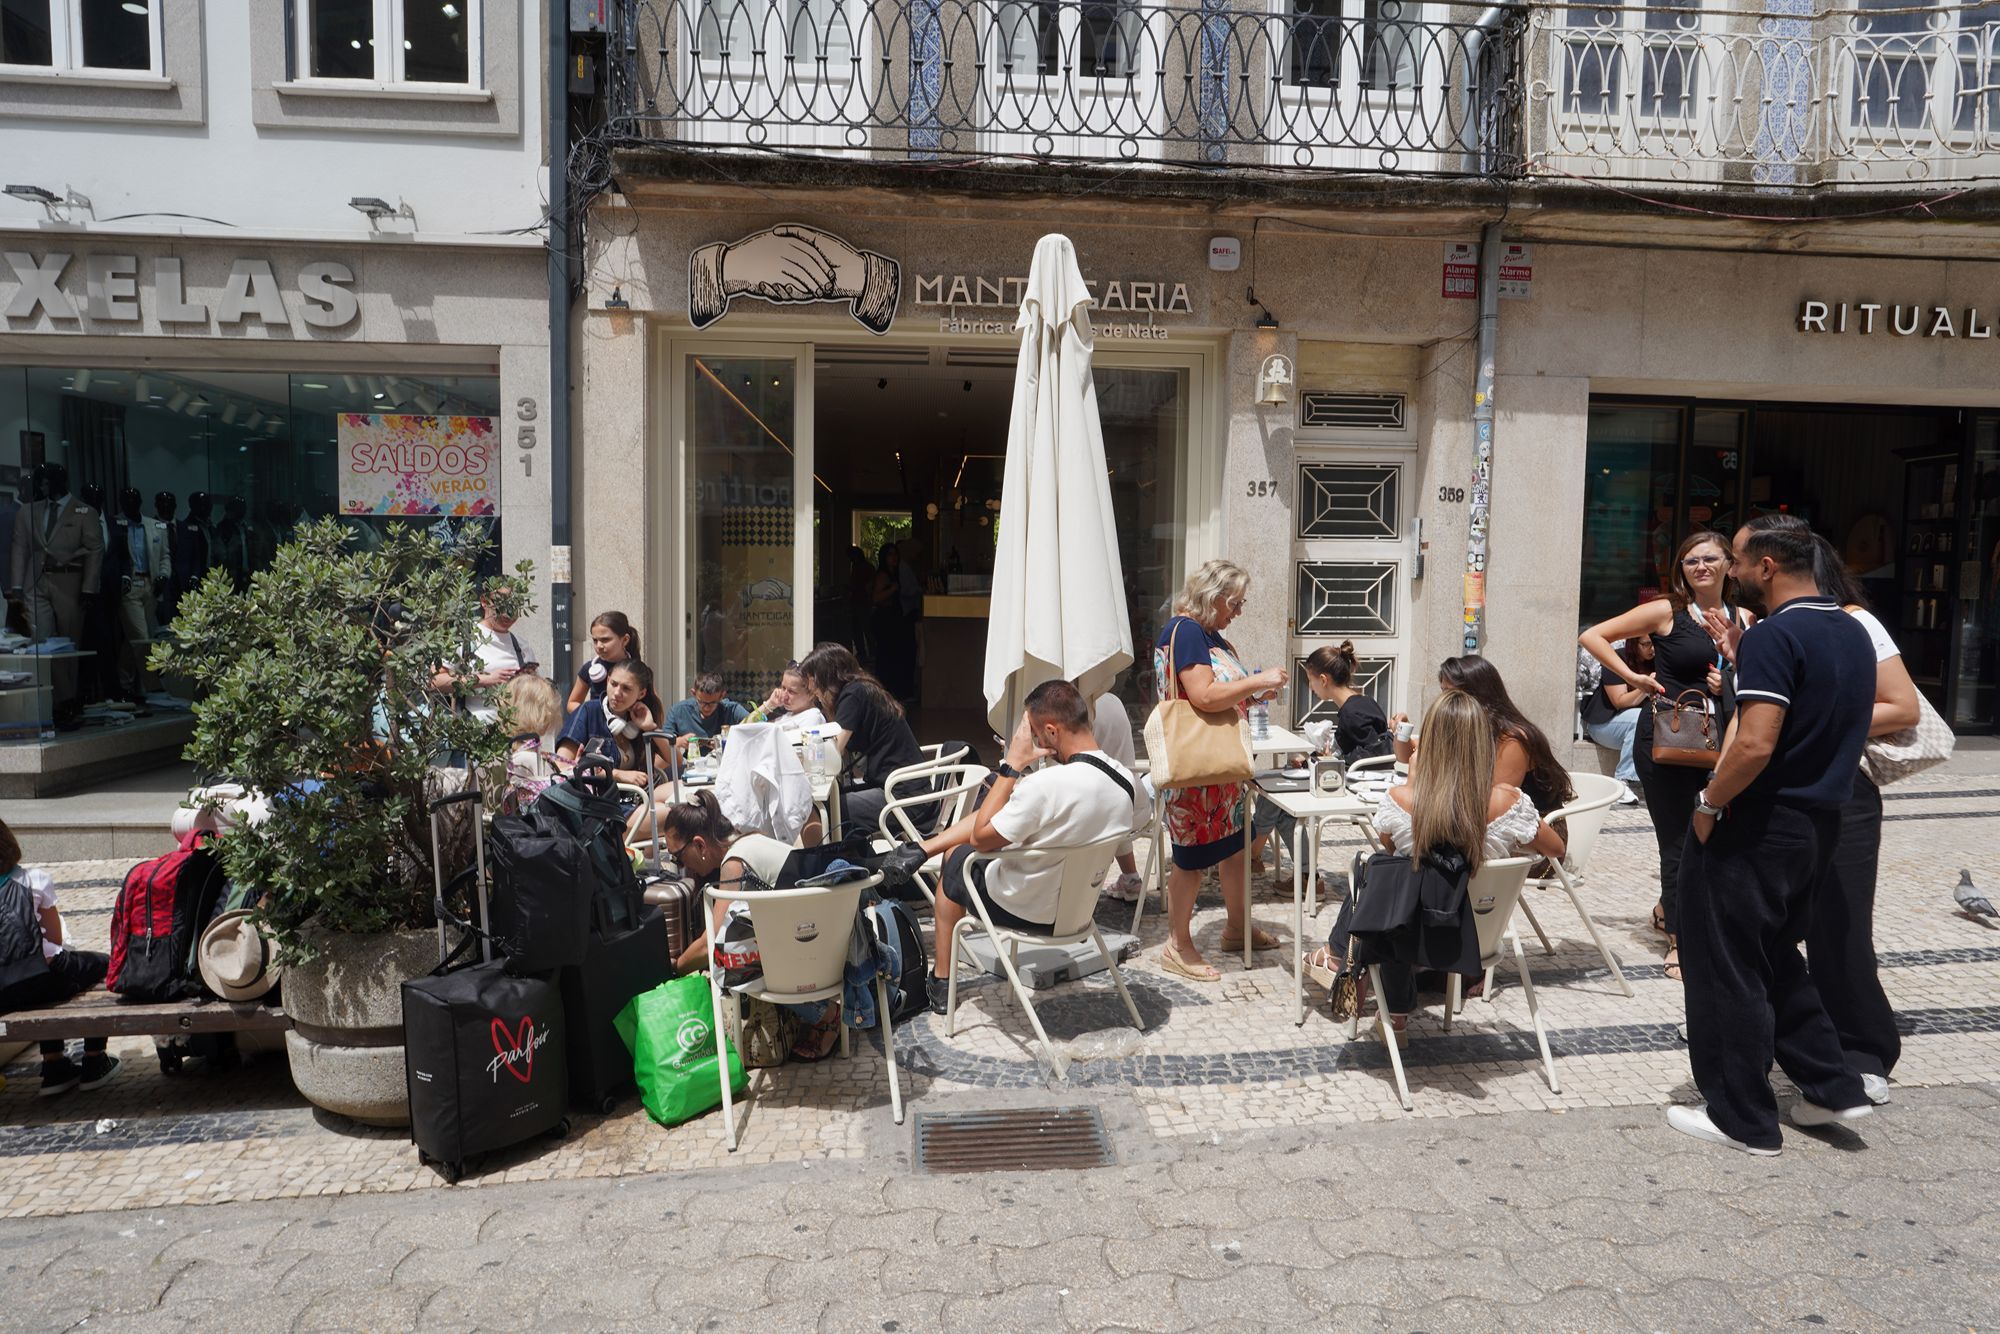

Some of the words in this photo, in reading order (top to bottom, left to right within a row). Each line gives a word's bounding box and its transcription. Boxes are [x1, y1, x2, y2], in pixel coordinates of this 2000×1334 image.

[1446, 265, 1476, 275] Alarme
[1499, 267, 1530, 276] Alarme
[3, 252, 359, 328] XELAS
[915, 274, 1193, 313] MANTARIA
[939, 316, 1004, 335] Fábrica
[1102, 322, 1123, 338] de
[1127, 324, 1168, 339] Nata
[517, 397, 538, 477] 351
[351, 443, 488, 475] SALDOS
[430, 476, 487, 495] VERÃO
[1247, 481, 1278, 497] 357
[1439, 486, 1464, 502] 359
[714, 947, 761, 970] NEW
[486, 1023, 549, 1083] Parfois
